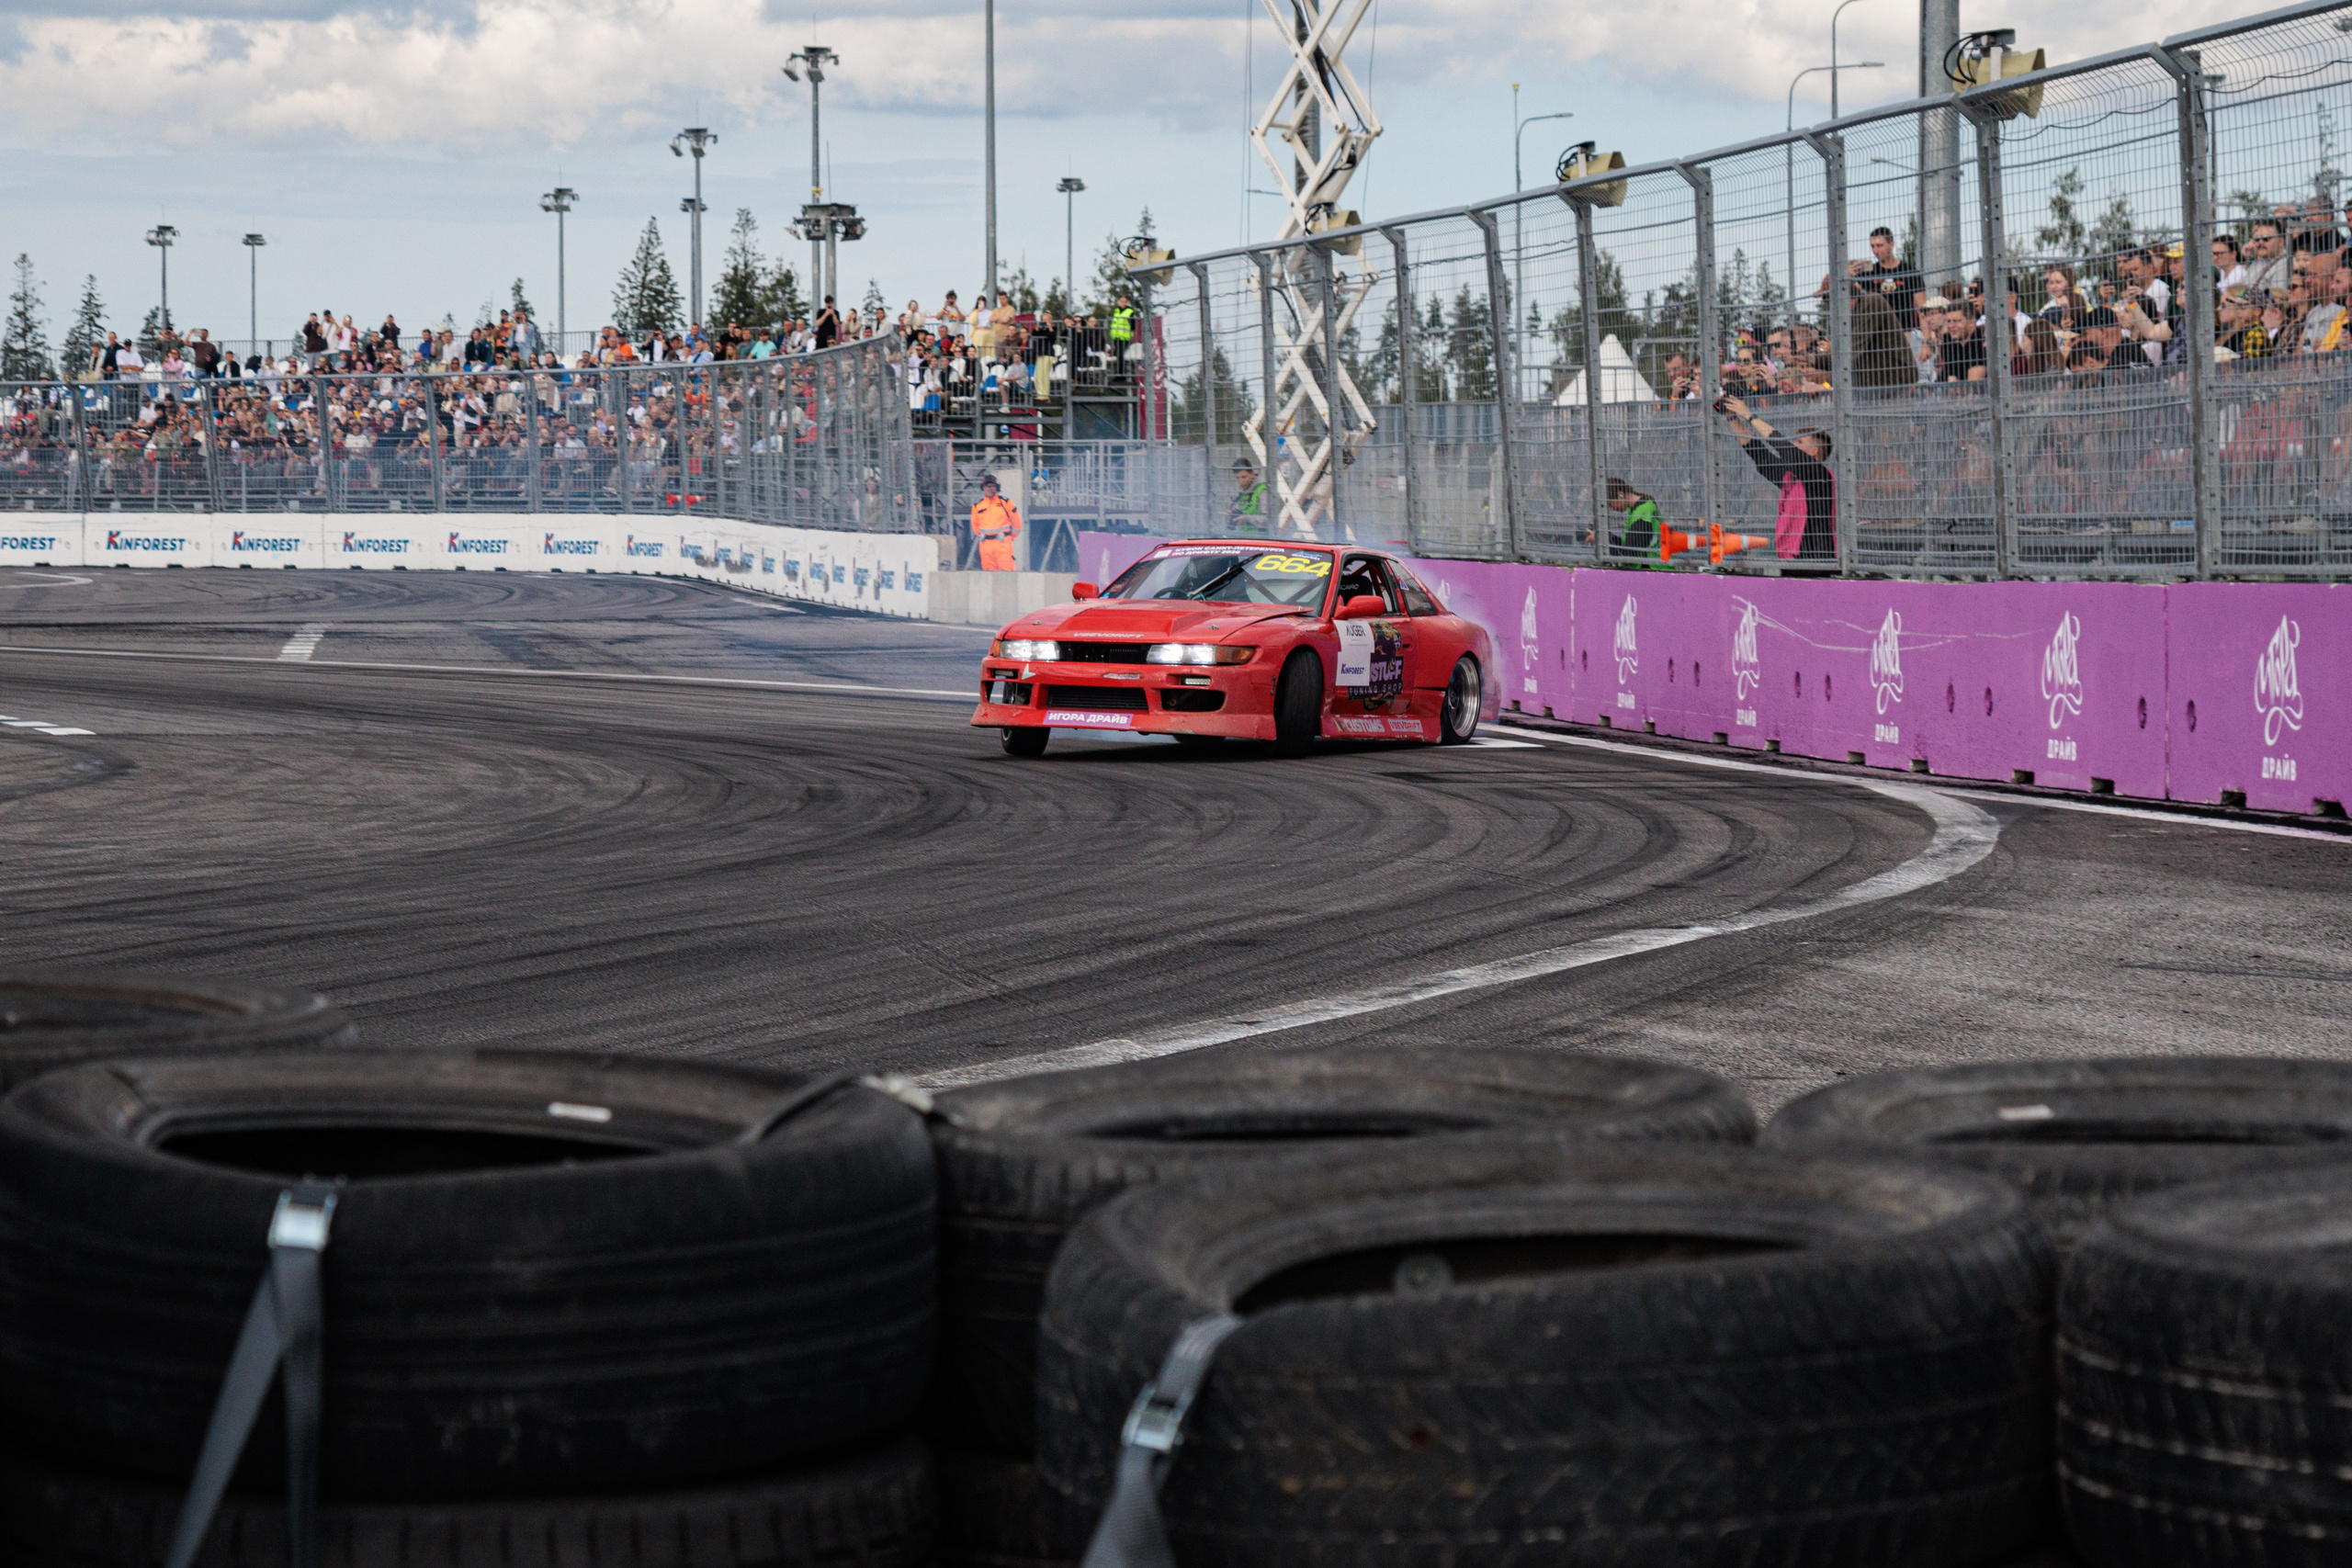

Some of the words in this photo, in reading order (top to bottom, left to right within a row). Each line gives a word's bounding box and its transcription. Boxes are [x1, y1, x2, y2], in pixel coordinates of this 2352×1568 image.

[106, 530, 186, 551] KINFOREST
[232, 531, 300, 551] KINFOREST
[343, 532, 410, 552] KINFOREST
[447, 532, 508, 553] KINFOREST
[544, 533, 599, 555] KINFOREST
[1255, 555, 1332, 578] 664
[1340, 663, 1365, 674] KINFOREST
[1349, 685, 1378, 696] TUNING
[1382, 682, 1402, 693] SHOP
[1048, 712, 1085, 722] ИГОРА
[1086, 713, 1128, 725] ДРАЙВ
[1343, 718, 1385, 733] CUSTOMS
[2047, 736, 2077, 761] ДРАЙВ
[2261, 753, 2297, 782] ДРАЙВ
